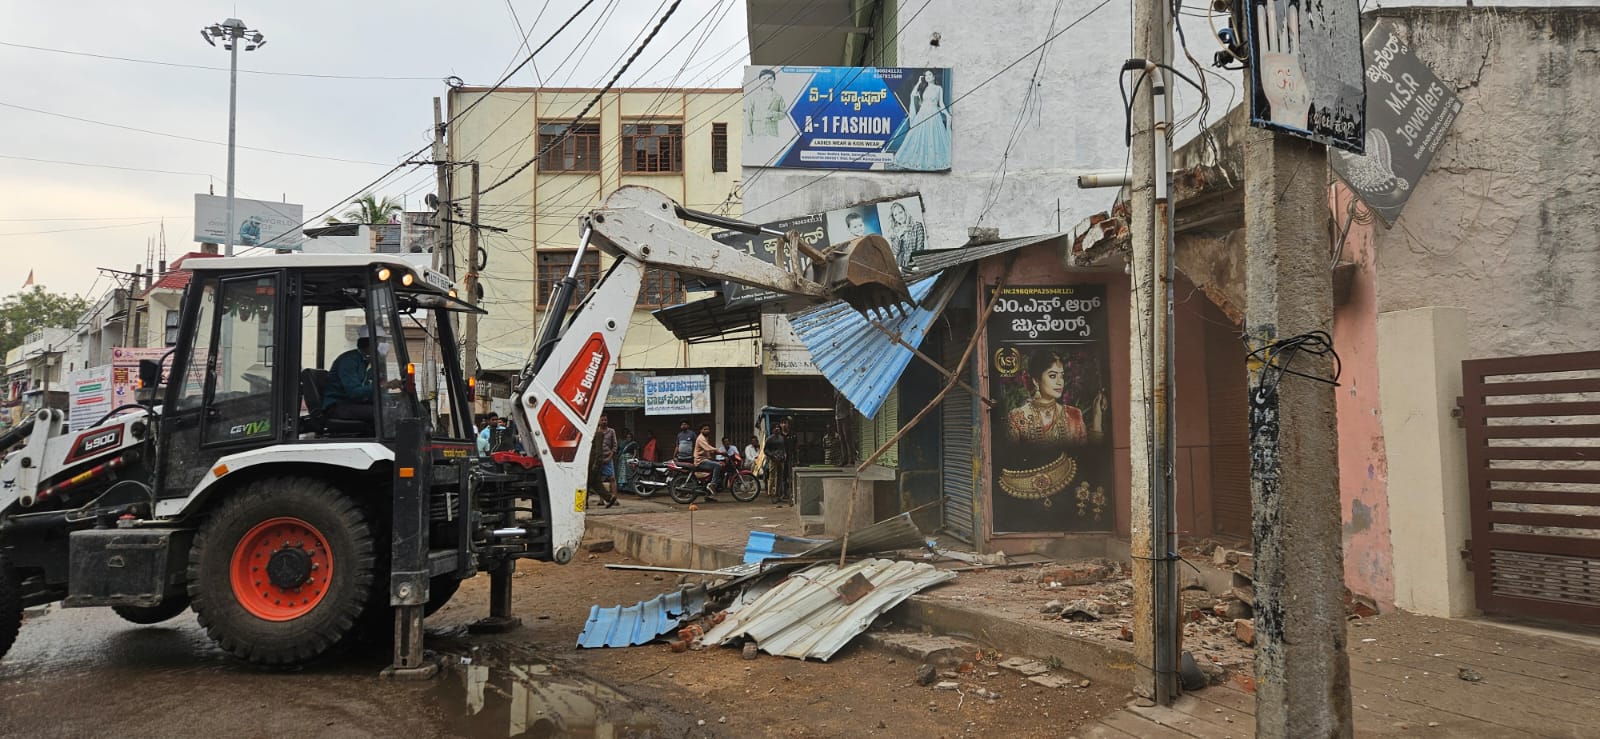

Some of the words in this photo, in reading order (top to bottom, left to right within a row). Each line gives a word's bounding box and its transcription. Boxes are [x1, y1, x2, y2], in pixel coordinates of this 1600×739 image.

[1385, 72, 1420, 115] M.S.R
[804, 115, 828, 133] A-1
[832, 116, 891, 135] FASHION
[1396, 81, 1444, 147] Jewellers
[993, 296, 1101, 313] ಎಂ.ಎಸ್.ಆರ್
[1011, 314, 1091, 339] ಜ್ಯುವೆಲರ್ಸ್
[581, 351, 604, 389] Bobcat
